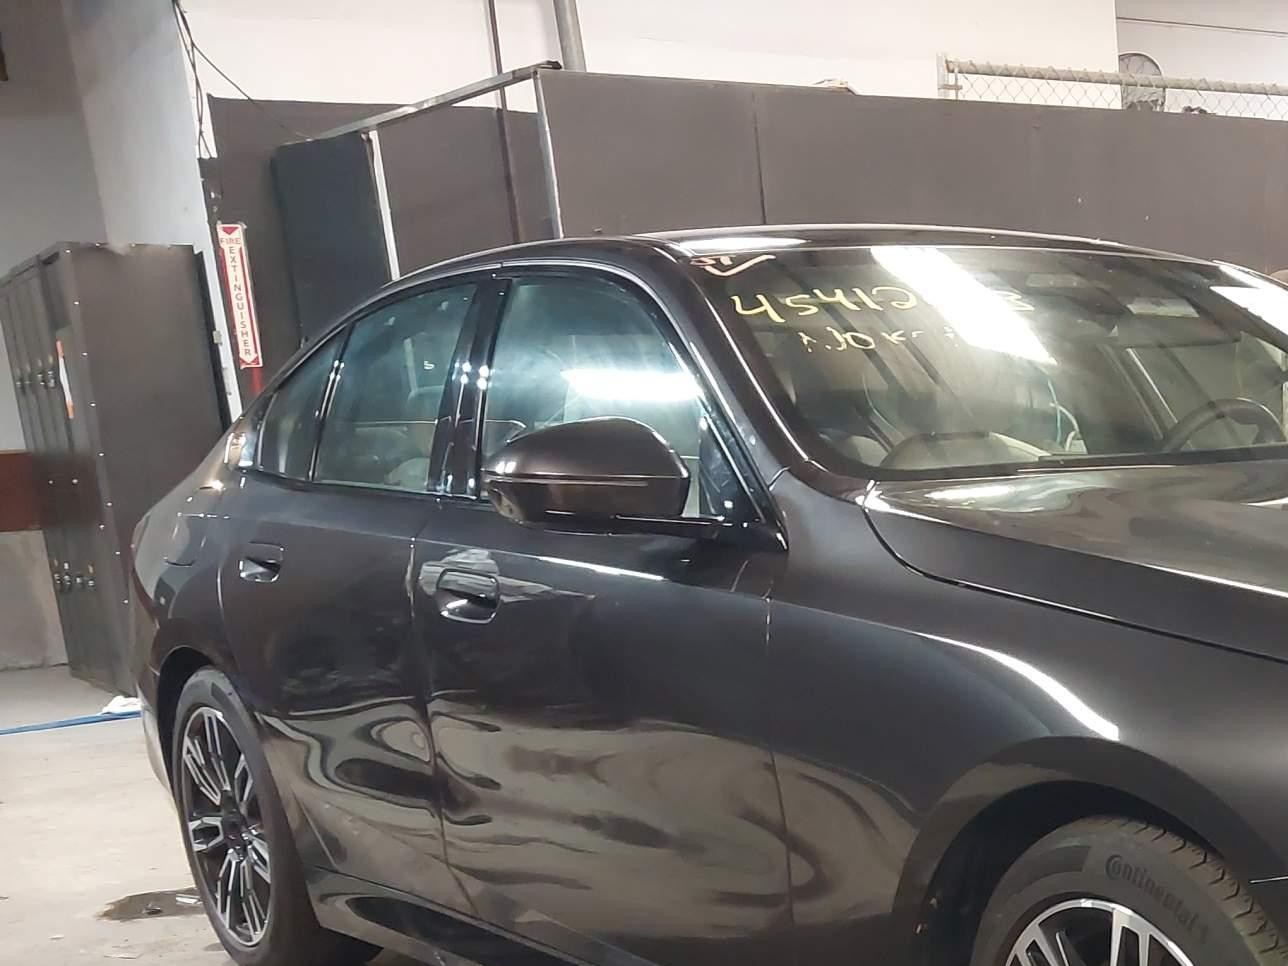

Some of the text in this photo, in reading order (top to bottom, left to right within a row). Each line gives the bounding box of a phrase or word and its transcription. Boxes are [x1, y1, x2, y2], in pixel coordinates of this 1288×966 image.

[220, 237, 242, 246] FIRE
[228, 246, 252, 357] EXTINGUISHER
[730, 285, 1036, 324] 454123
[1104, 853, 1201, 933] Continental
